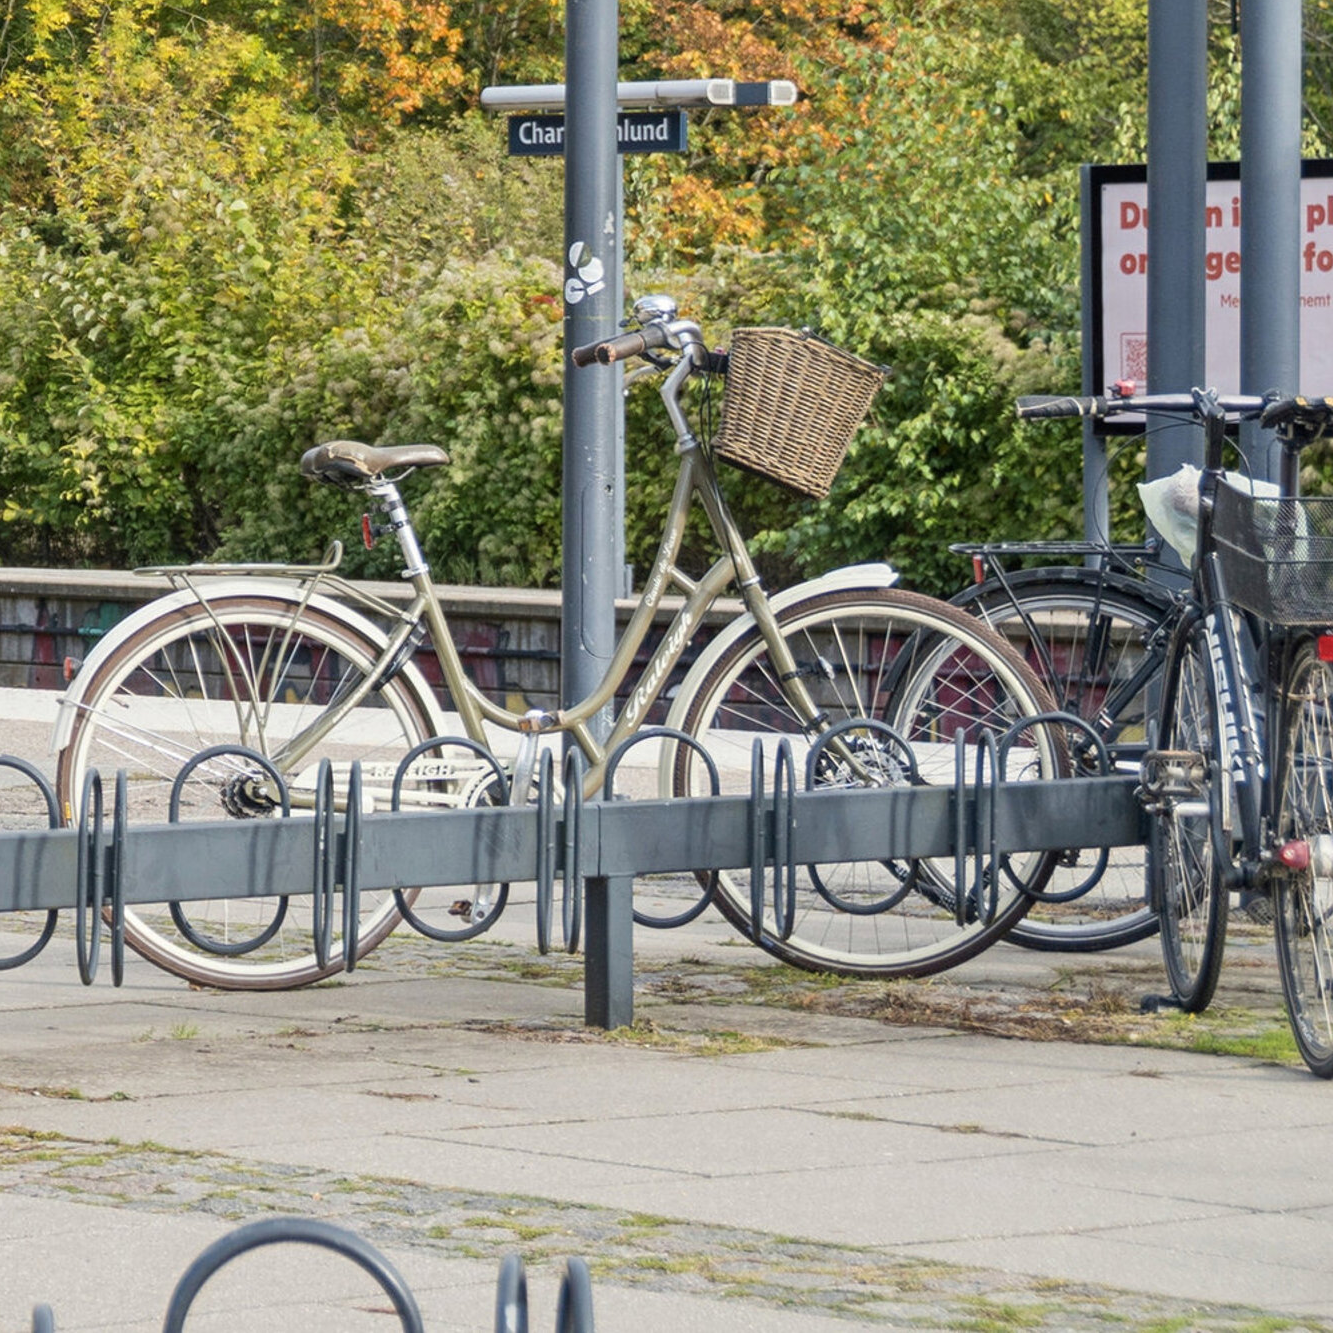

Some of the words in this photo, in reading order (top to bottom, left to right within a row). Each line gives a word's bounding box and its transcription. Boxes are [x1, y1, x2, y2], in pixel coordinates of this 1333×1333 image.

[518, 117, 669, 145] Charlund
[625, 611, 693, 728] Raleigh
[373, 765, 453, 777] RAEIGH
